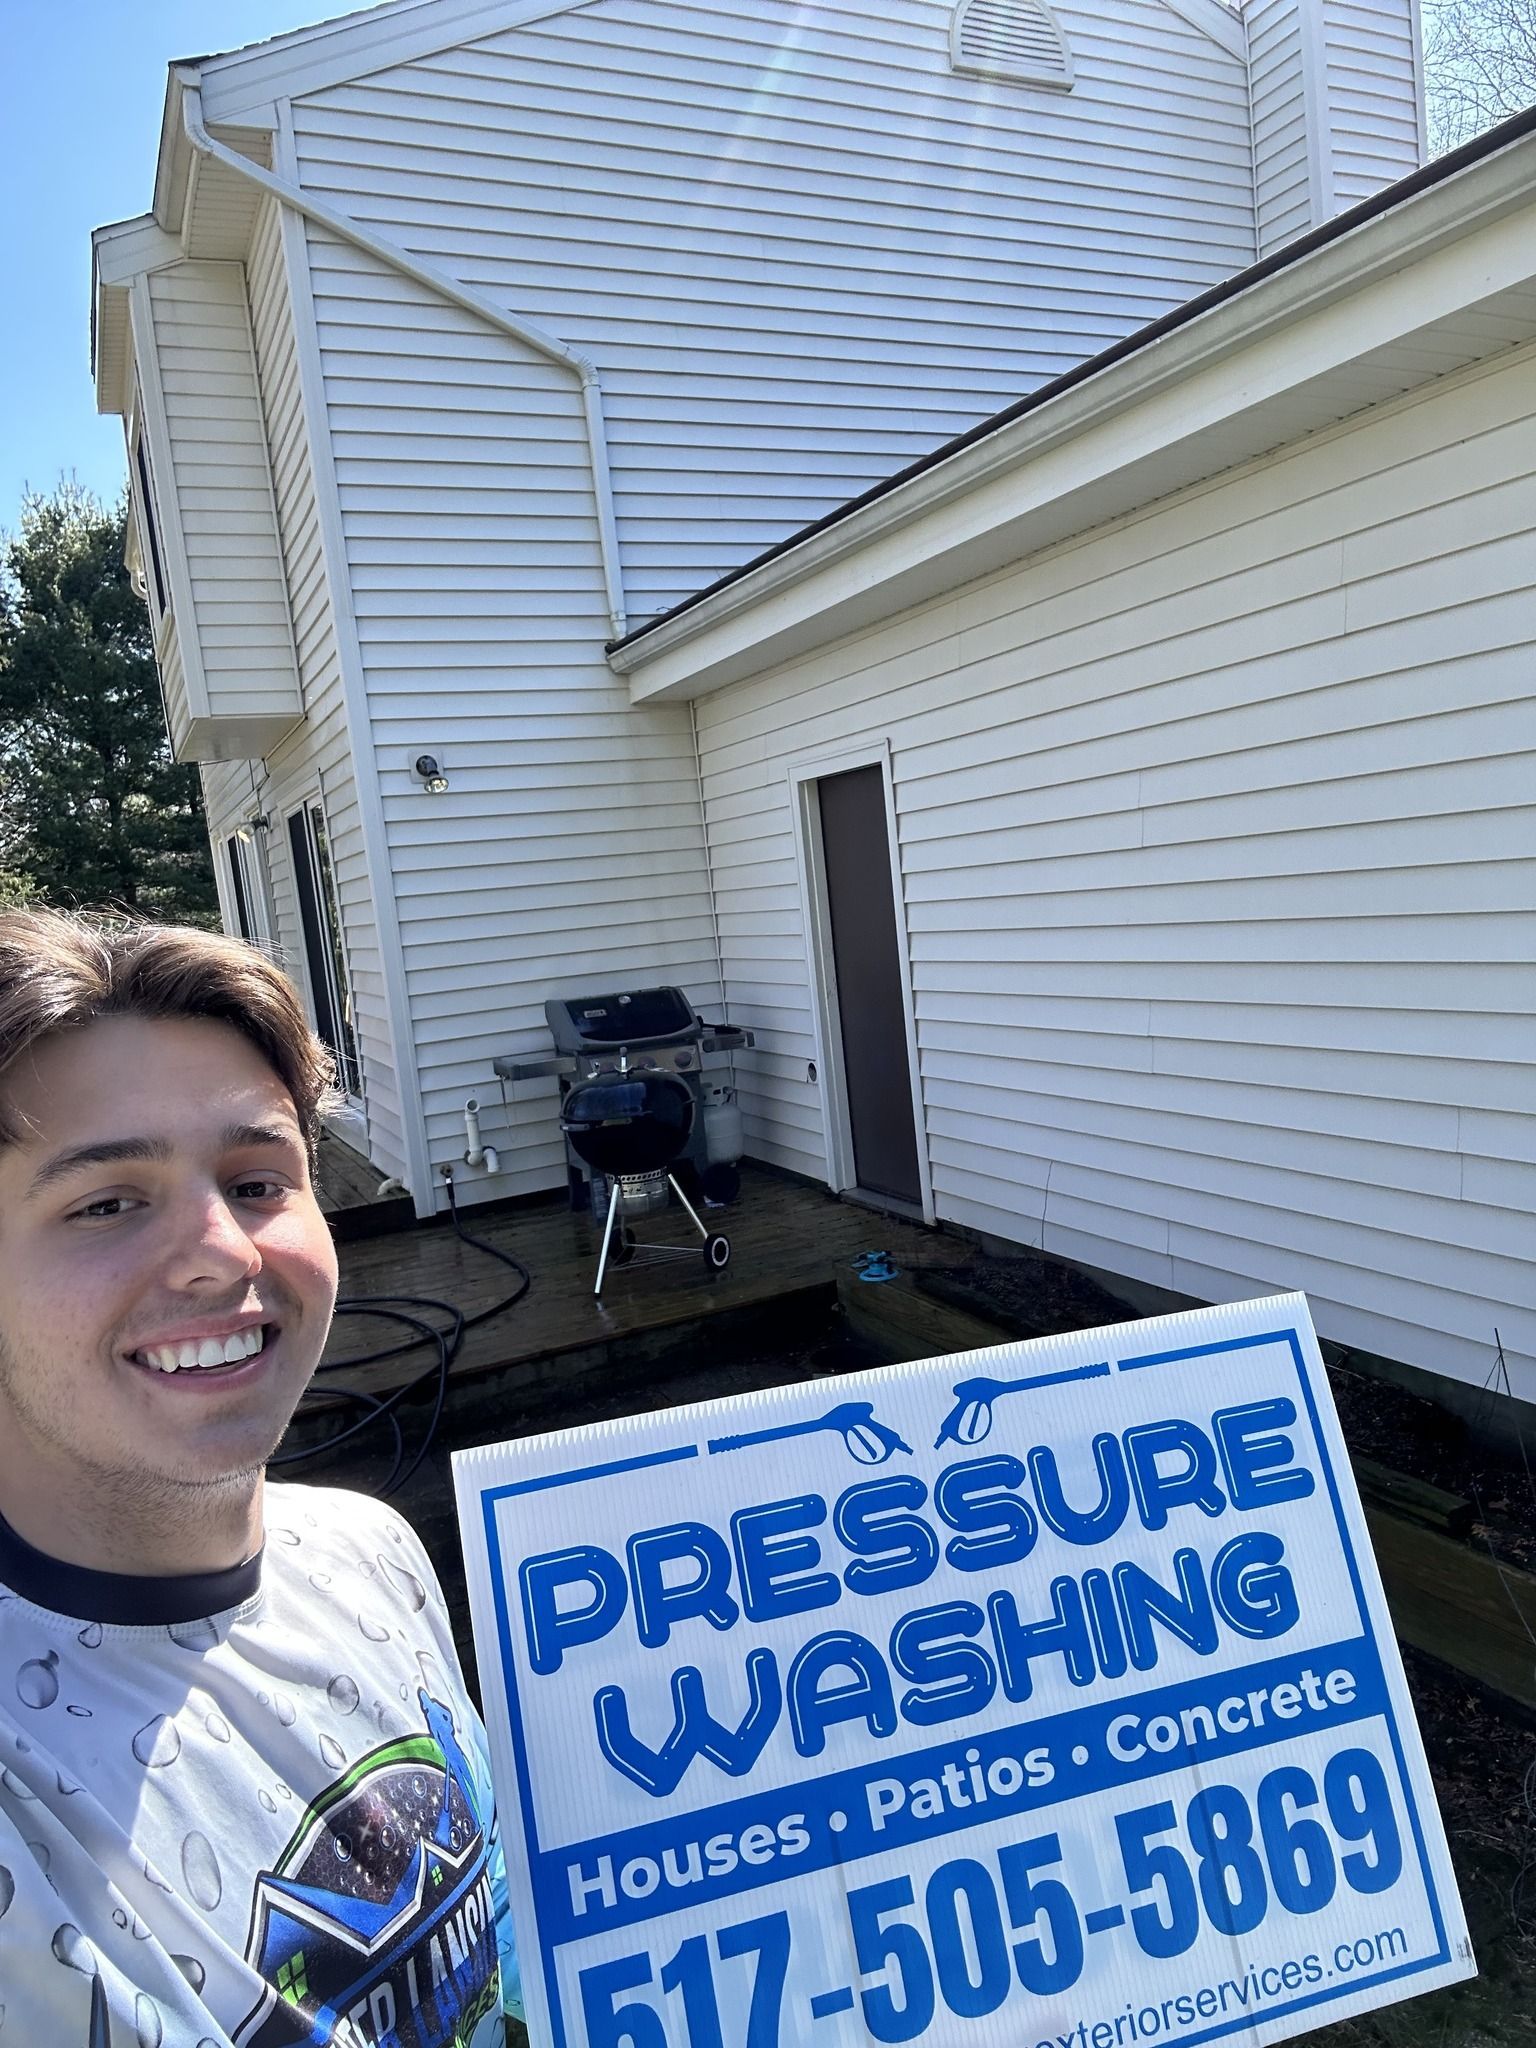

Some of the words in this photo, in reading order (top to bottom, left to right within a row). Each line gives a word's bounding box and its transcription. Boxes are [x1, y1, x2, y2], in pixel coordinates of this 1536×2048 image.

[517, 1396, 1316, 1677] PRESSURE
[592, 1531, 1301, 1799] WASHING
[567, 1814, 811, 1916] Houses
[865, 1747, 1055, 1832] Patios
[1106, 1669, 1357, 1762] Concrete
[577, 1747, 1403, 2048] 517-505-5869
